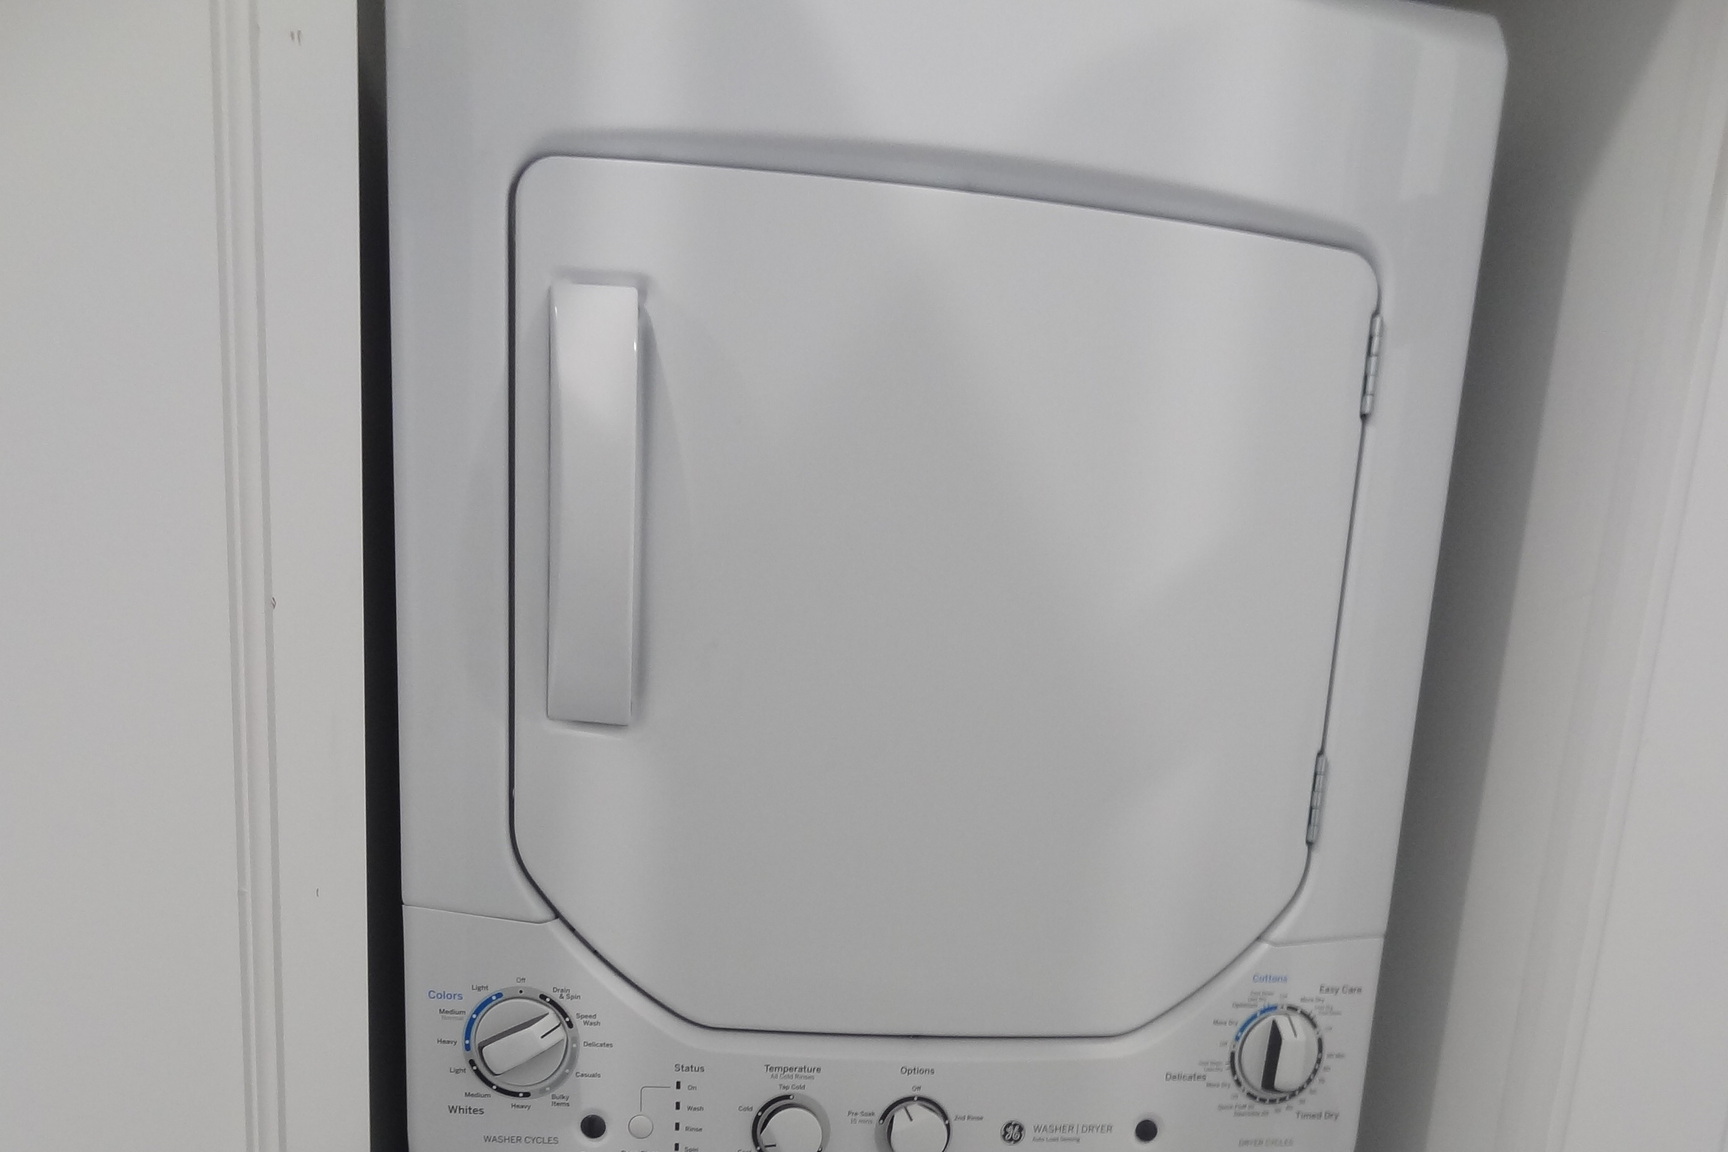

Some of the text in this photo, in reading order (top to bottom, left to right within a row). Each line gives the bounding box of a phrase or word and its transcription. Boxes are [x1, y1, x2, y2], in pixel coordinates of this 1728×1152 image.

[1253, 974, 1288, 983] Cottons
[428, 990, 464, 1000] Colors
[1319, 985, 1362, 995] Easy Care
[565, 993, 581, 1001] Spin
[576, 1013, 597, 1021] Speed
[437, 1038, 457, 1046] Heavy
[674, 1063, 705, 1073] Status
[764, 1064, 822, 1075] Temperature
[900, 1066, 935, 1076] Options
[1165, 1072, 1207, 1082] Delicates
[778, 1083, 790, 1091] Tap
[551, 1094, 570, 1102] Bulky
[448, 1105, 485, 1115] Whites
[511, 1103, 531, 1111] Heavy
[1296, 1111, 1339, 1121] Timed Dry
[684, 1125, 703, 1133] Rinse
[1033, 1124, 1075, 1134] WASHER
[1081, 1124, 1113, 1134] DRYER
[483, 1135, 559, 1145] WASHER CYCLES
